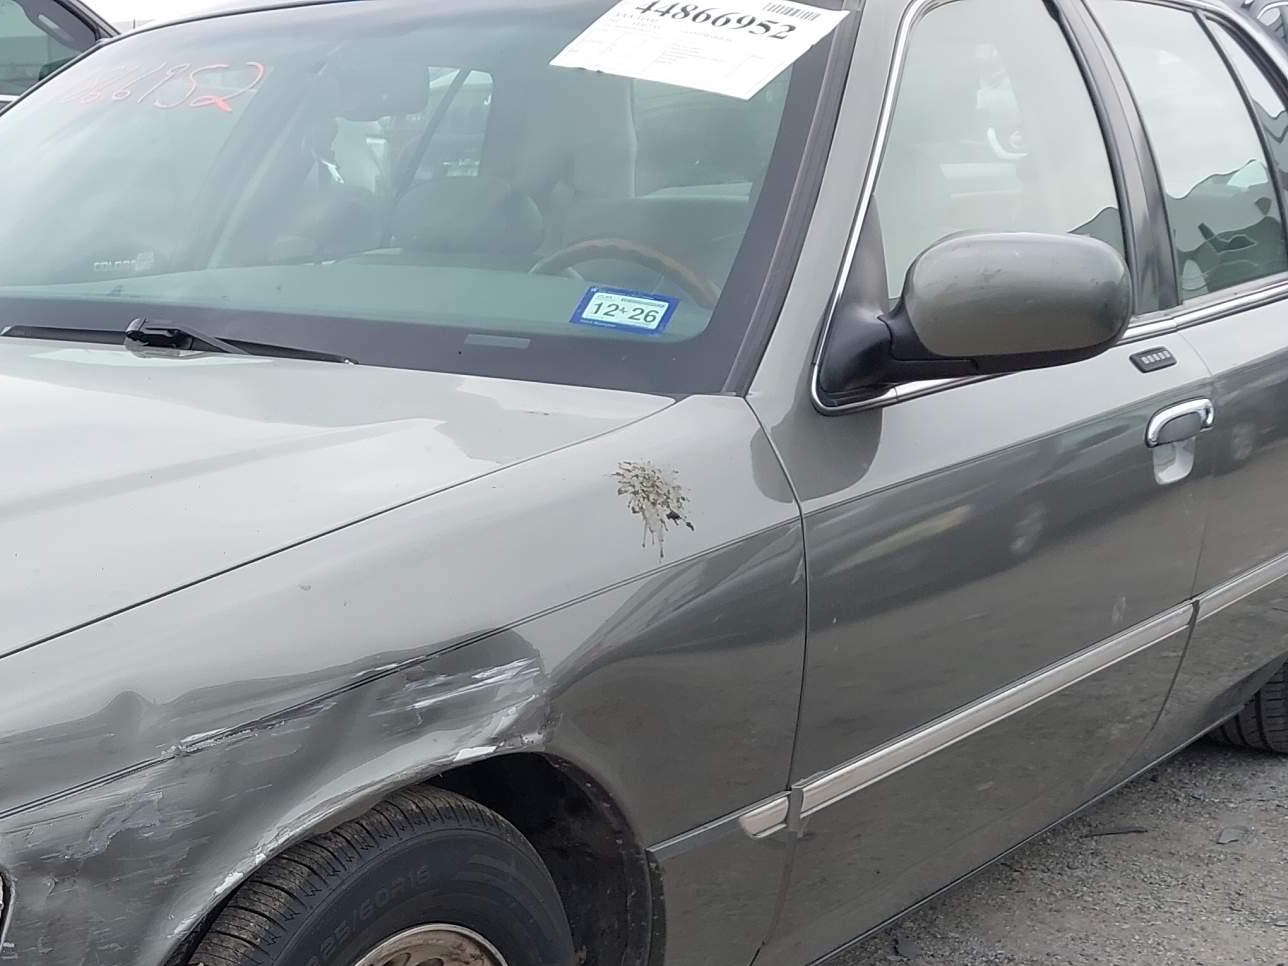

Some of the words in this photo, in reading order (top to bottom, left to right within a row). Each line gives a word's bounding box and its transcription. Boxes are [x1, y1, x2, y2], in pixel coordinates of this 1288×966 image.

[634, 0, 797, 40] 44866952
[591, 301, 620, 318] 12
[627, 307, 660, 324] 26
